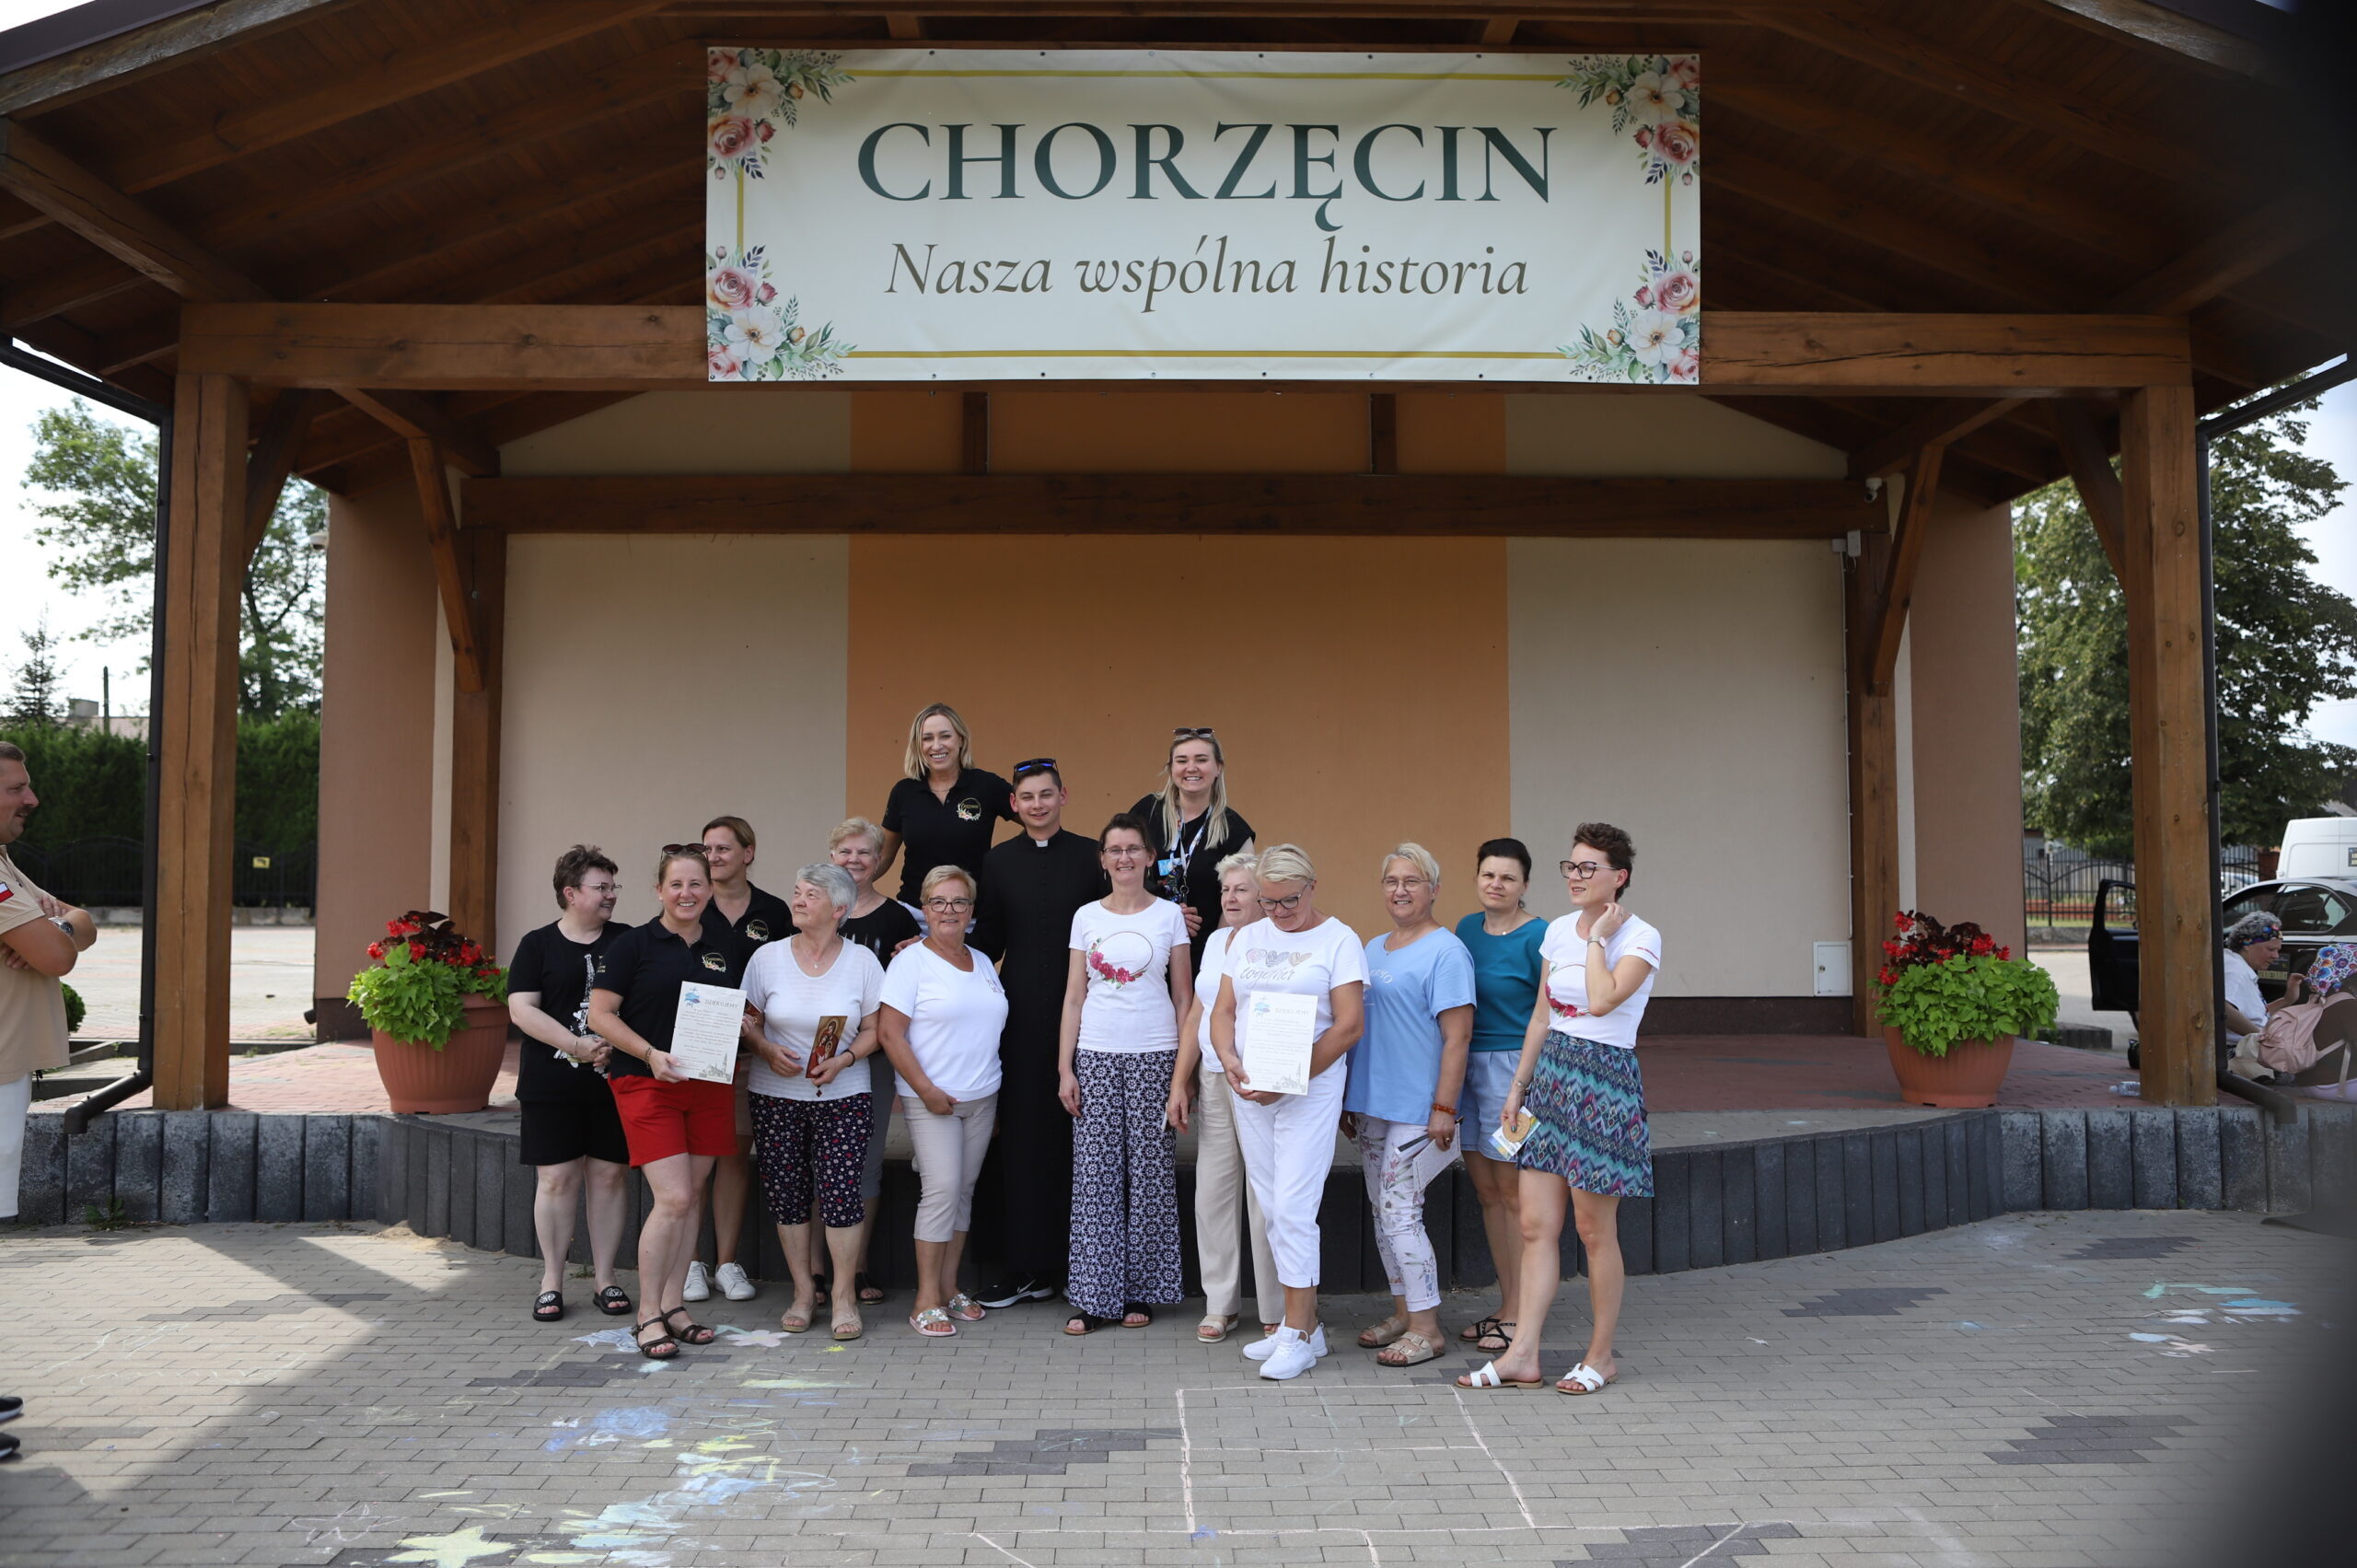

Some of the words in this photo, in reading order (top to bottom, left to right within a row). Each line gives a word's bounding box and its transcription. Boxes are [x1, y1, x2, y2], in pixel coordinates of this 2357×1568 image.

[858, 122, 1557, 232] CHORZĘCIN
[885, 243, 1052, 294] Nasza
[1074, 234, 1297, 313] wspólna
[1319, 235, 1527, 294] historia
